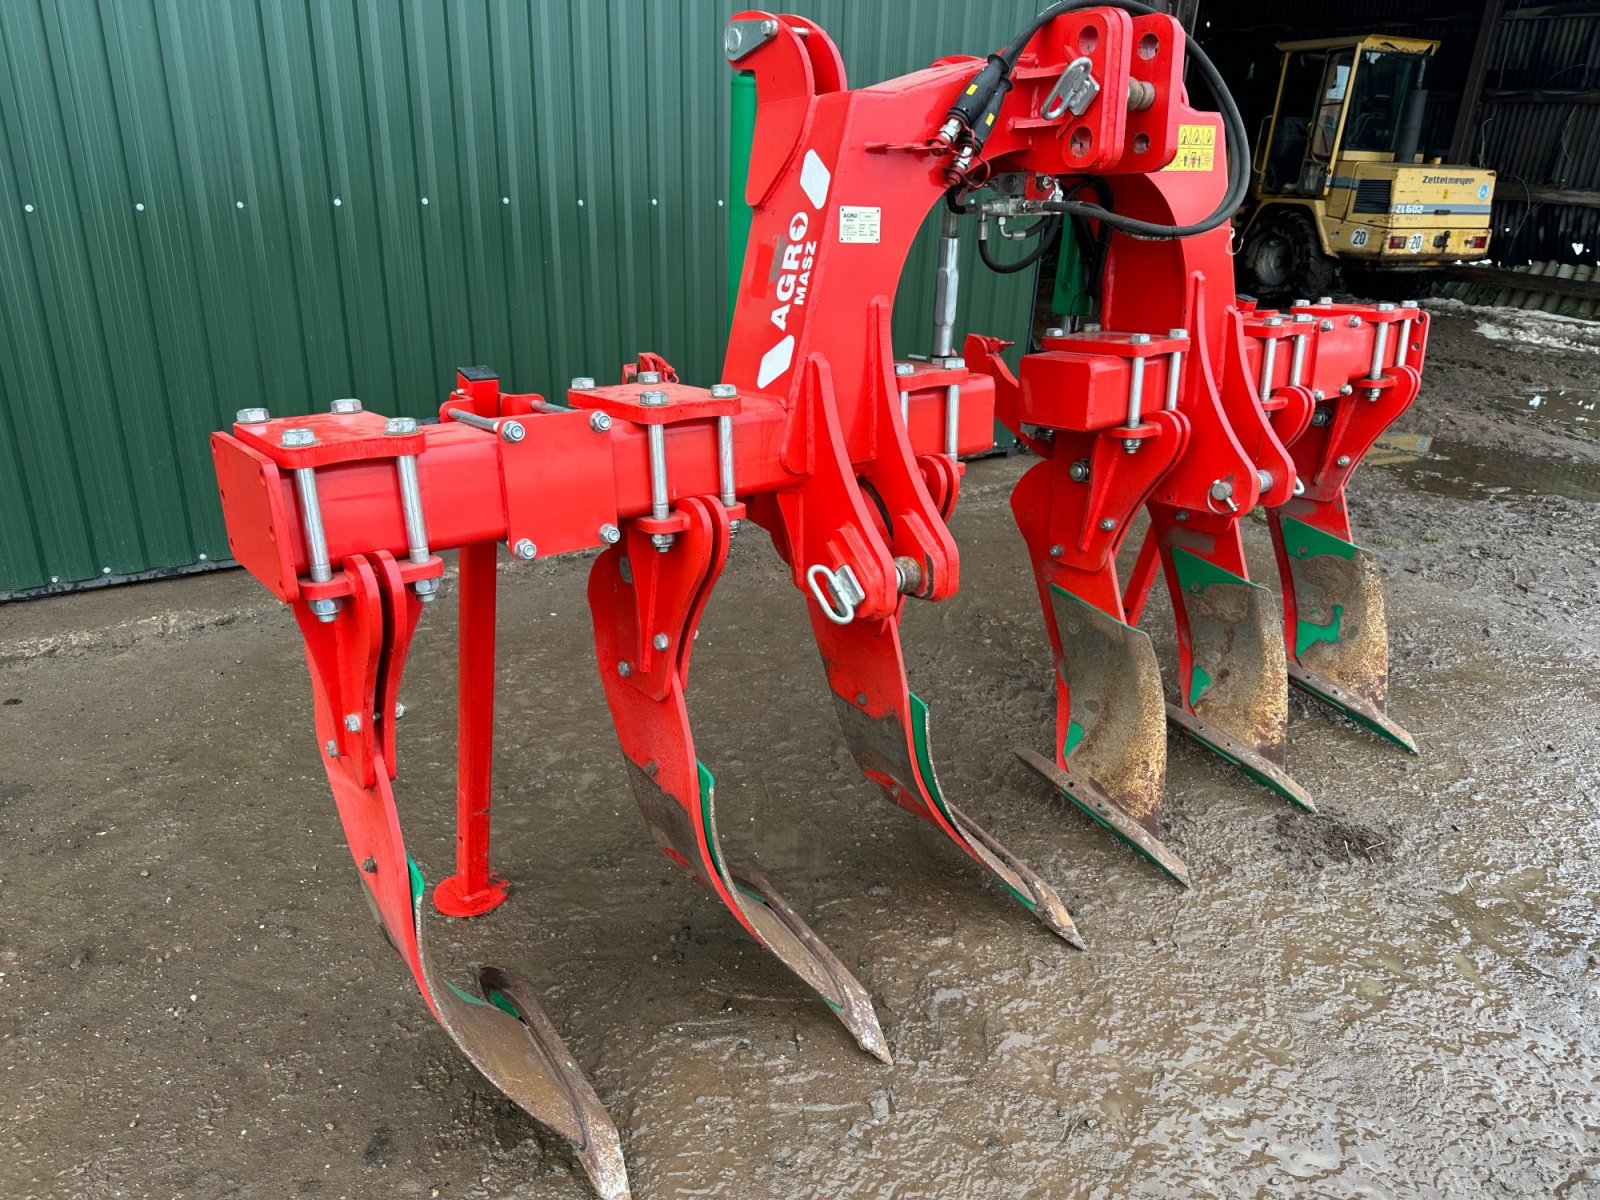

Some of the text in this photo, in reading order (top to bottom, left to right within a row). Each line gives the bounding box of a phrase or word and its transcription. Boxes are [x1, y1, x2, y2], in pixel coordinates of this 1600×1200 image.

[1422, 175, 1475, 186] Zettelmeyer
[1352, 231, 1367, 245] 20
[1410, 236, 1422, 250] 20
[770, 211, 809, 332] AGRO
[793, 240, 817, 306] MASZ
